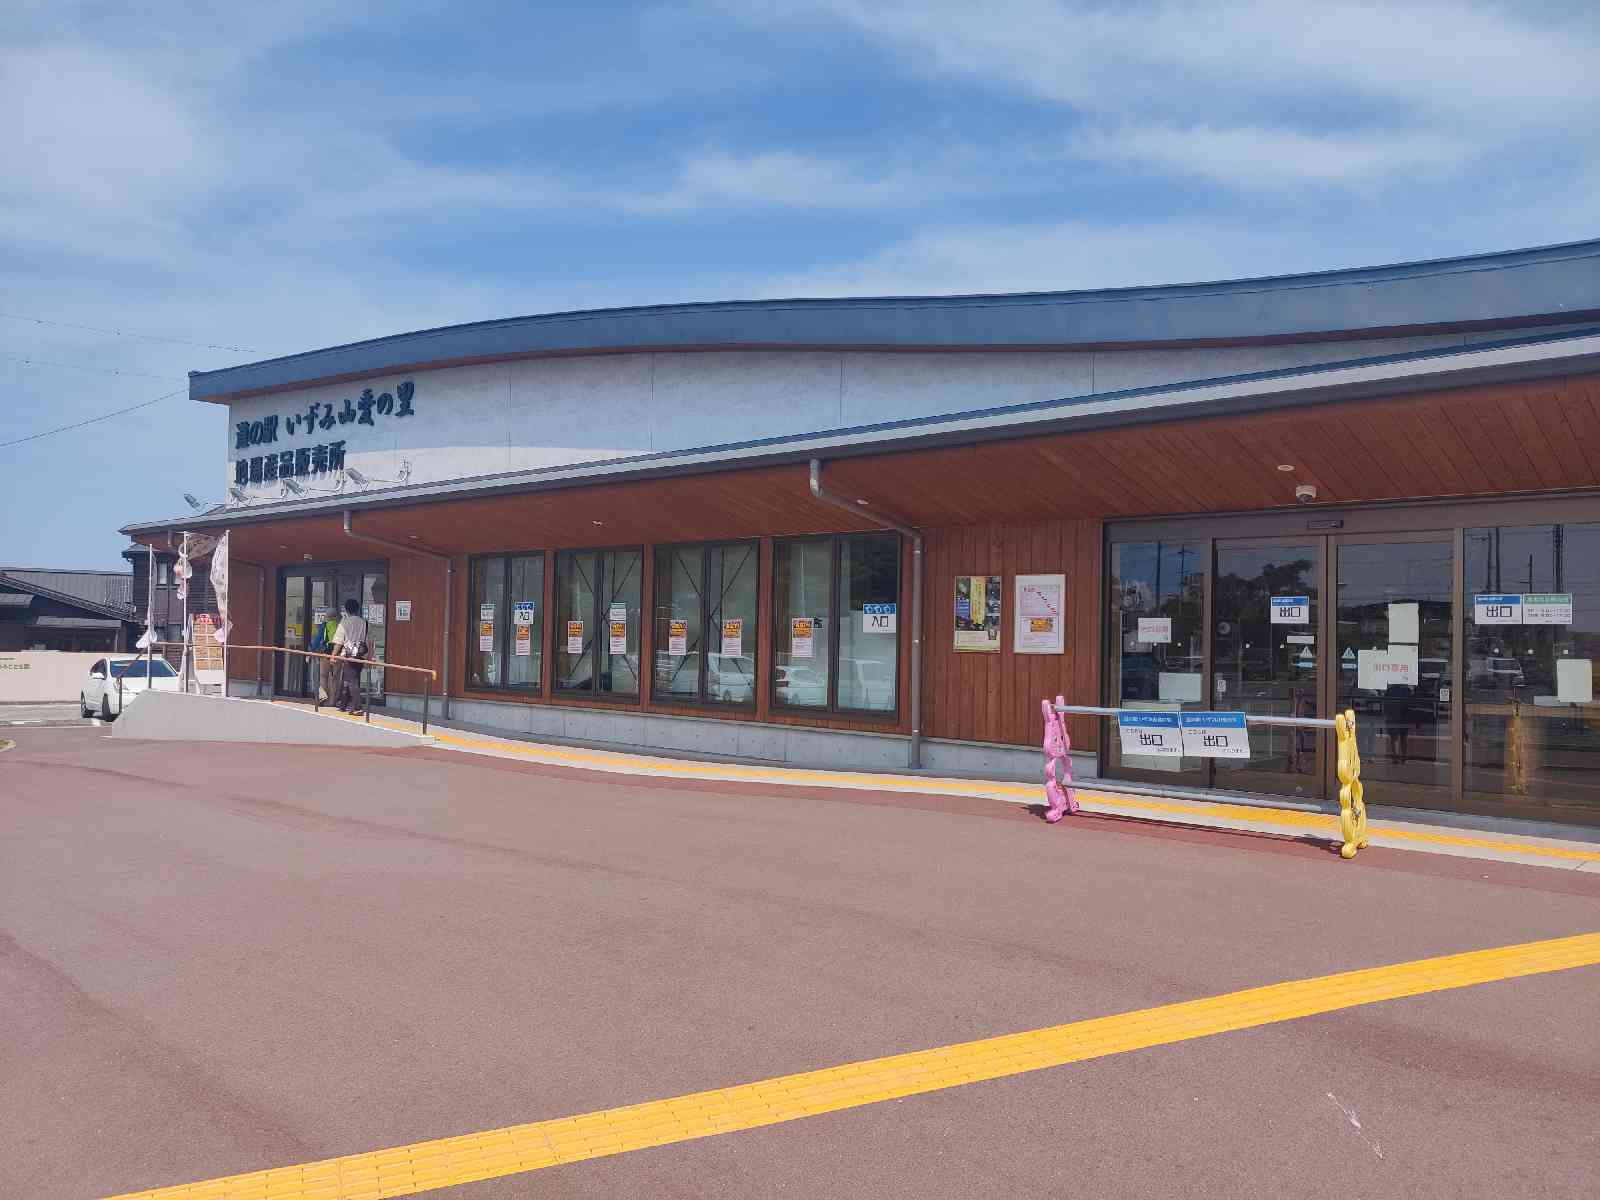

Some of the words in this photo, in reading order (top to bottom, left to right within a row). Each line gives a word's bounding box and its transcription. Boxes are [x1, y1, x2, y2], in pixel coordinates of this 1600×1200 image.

[235, 414, 279, 450] 道の駅
[1279, 607, 1301, 618] 出口
[1486, 605, 1513, 618] 出口
[871, 615, 889, 628] 入口
[1139, 733, 1163, 746] 出口
[1203, 735, 1229, 748] 出口
